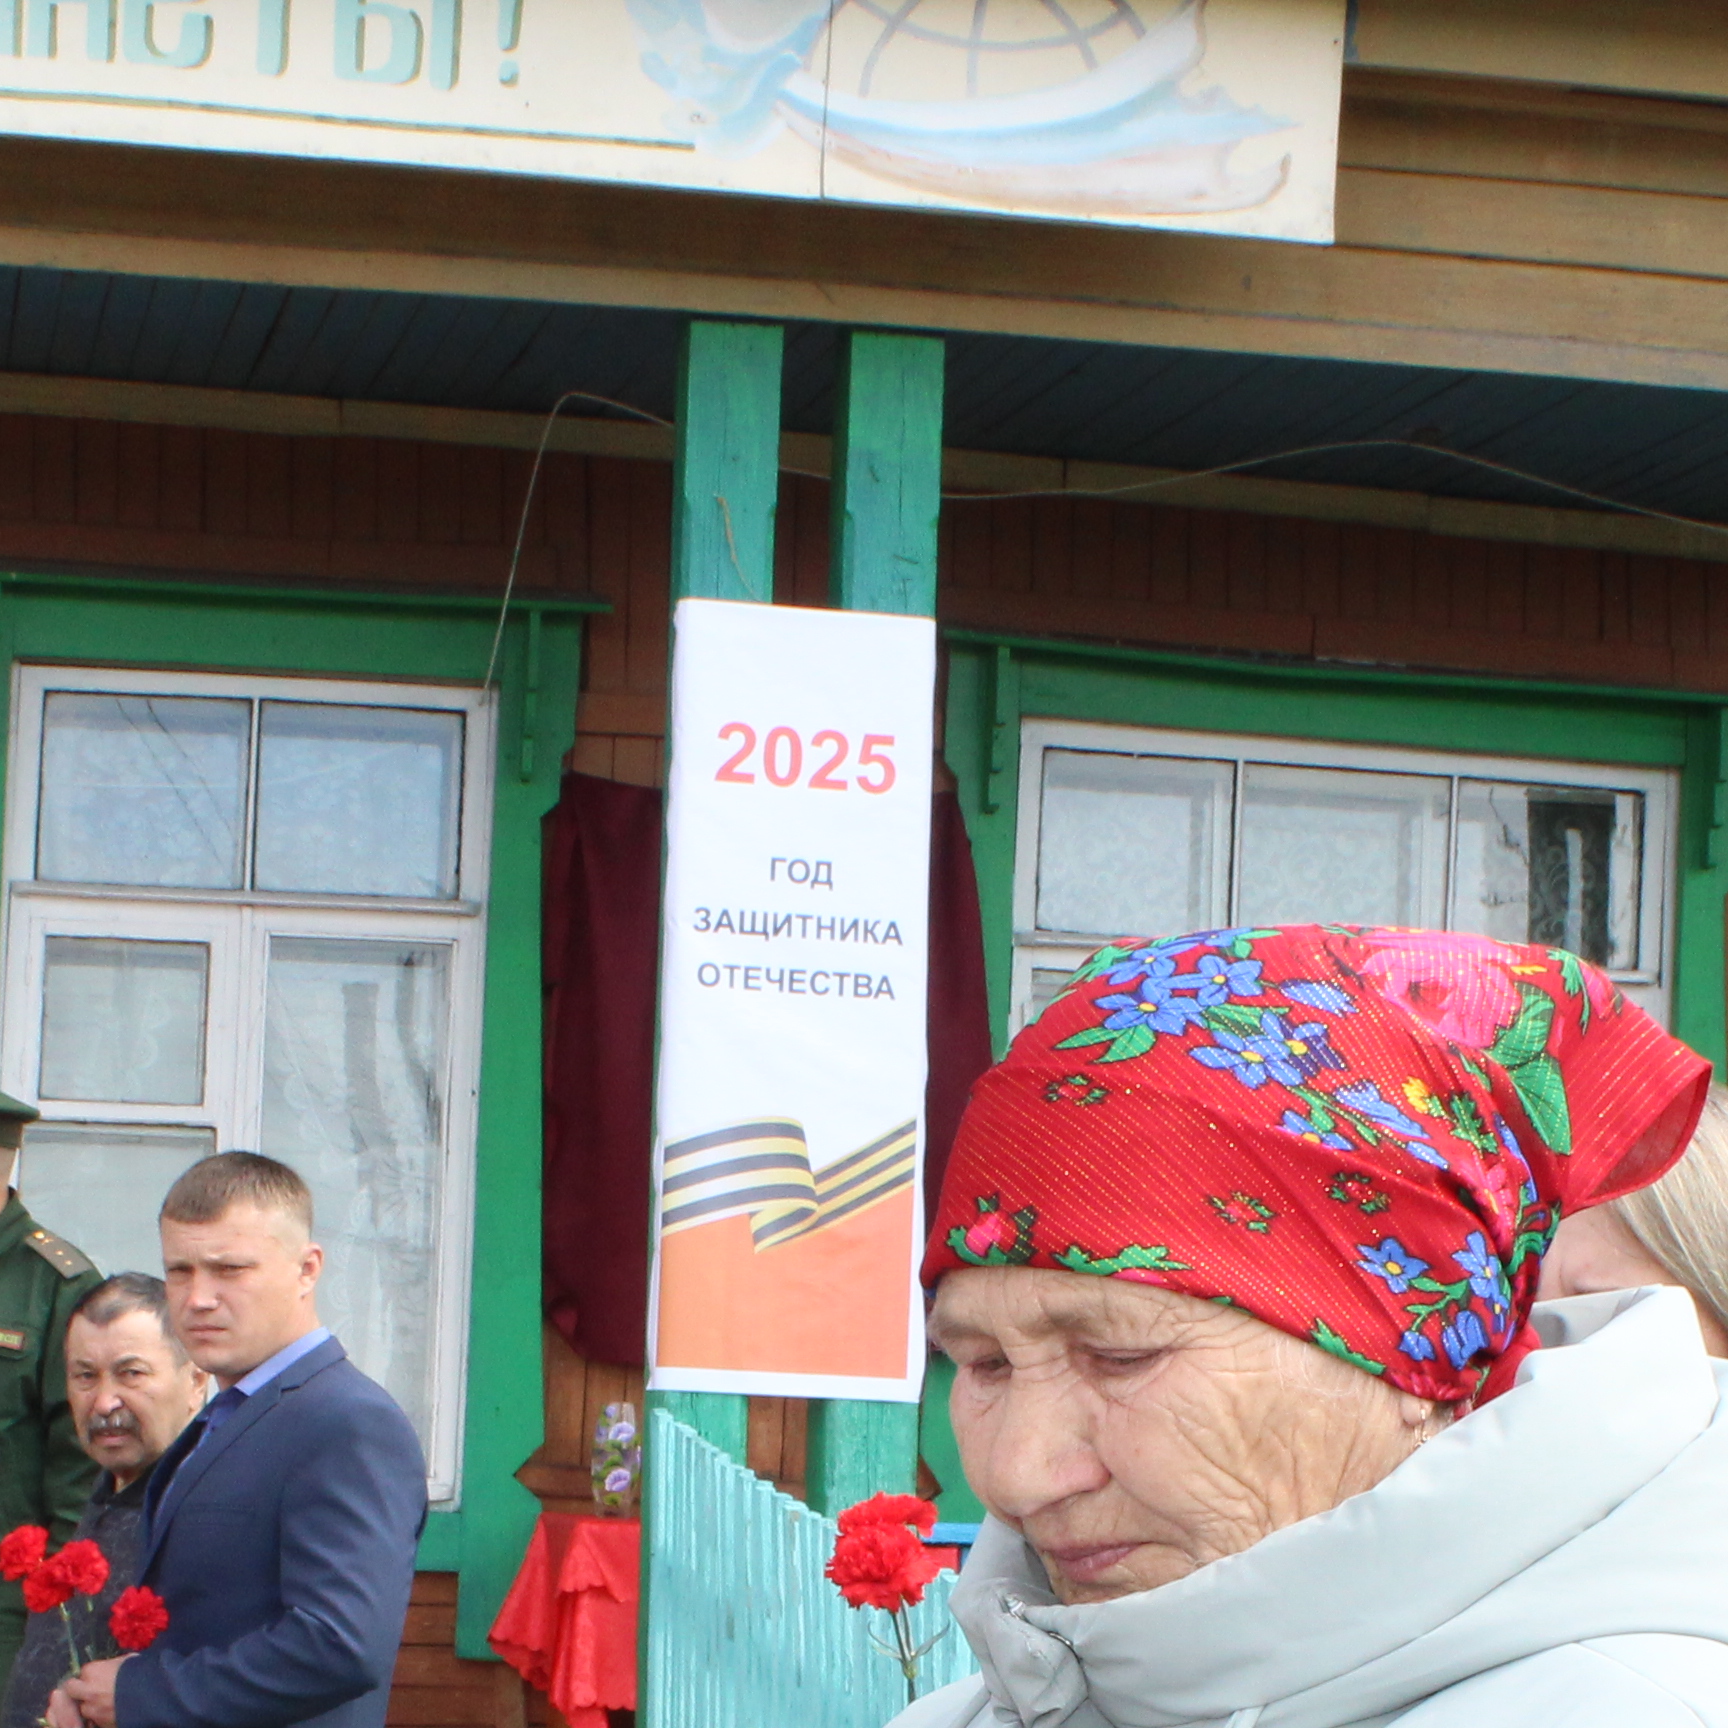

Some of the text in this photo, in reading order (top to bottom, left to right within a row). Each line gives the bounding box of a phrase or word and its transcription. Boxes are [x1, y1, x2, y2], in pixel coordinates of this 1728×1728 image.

[714, 721, 897, 795] 2025
[769, 856, 834, 891] ГОД
[692, 906, 904, 947] ЗАЩИТНИКА
[696, 962, 896, 1001] ОТЕЧЕСТВА
